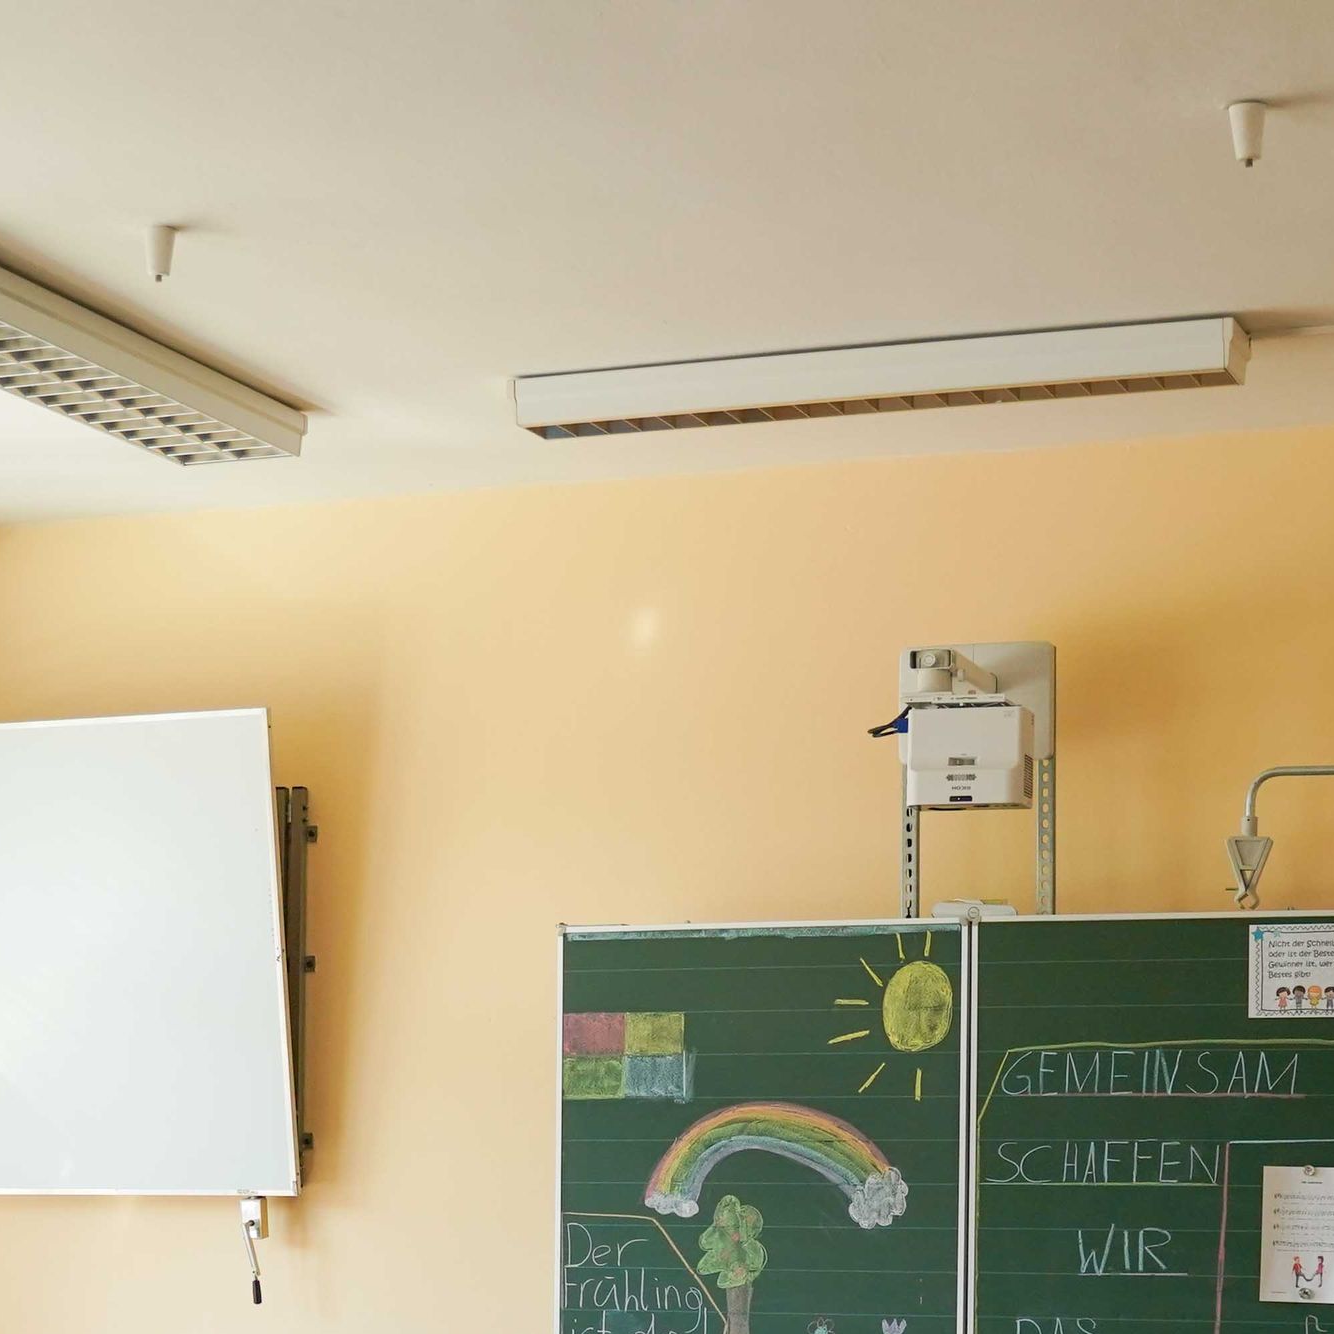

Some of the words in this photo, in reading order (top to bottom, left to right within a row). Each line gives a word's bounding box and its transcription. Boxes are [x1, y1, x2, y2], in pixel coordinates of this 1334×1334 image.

[1268, 940, 1290, 948] Nicht
[1268, 950, 1286, 958] oder
[1287, 950, 1298, 958] ist
[1268, 960, 1303, 968] Gewinner
[1268, 971, 1292, 979] Bestes
[1000, 1048, 1299, 1096] GEMEINSAM
[984, 1138, 1220, 1184] SCHAFFEN
[564, 1222, 649, 1268] Der
[1077, 1223, 1172, 1276] WIR
[564, 1267, 703, 1333] Frühling
